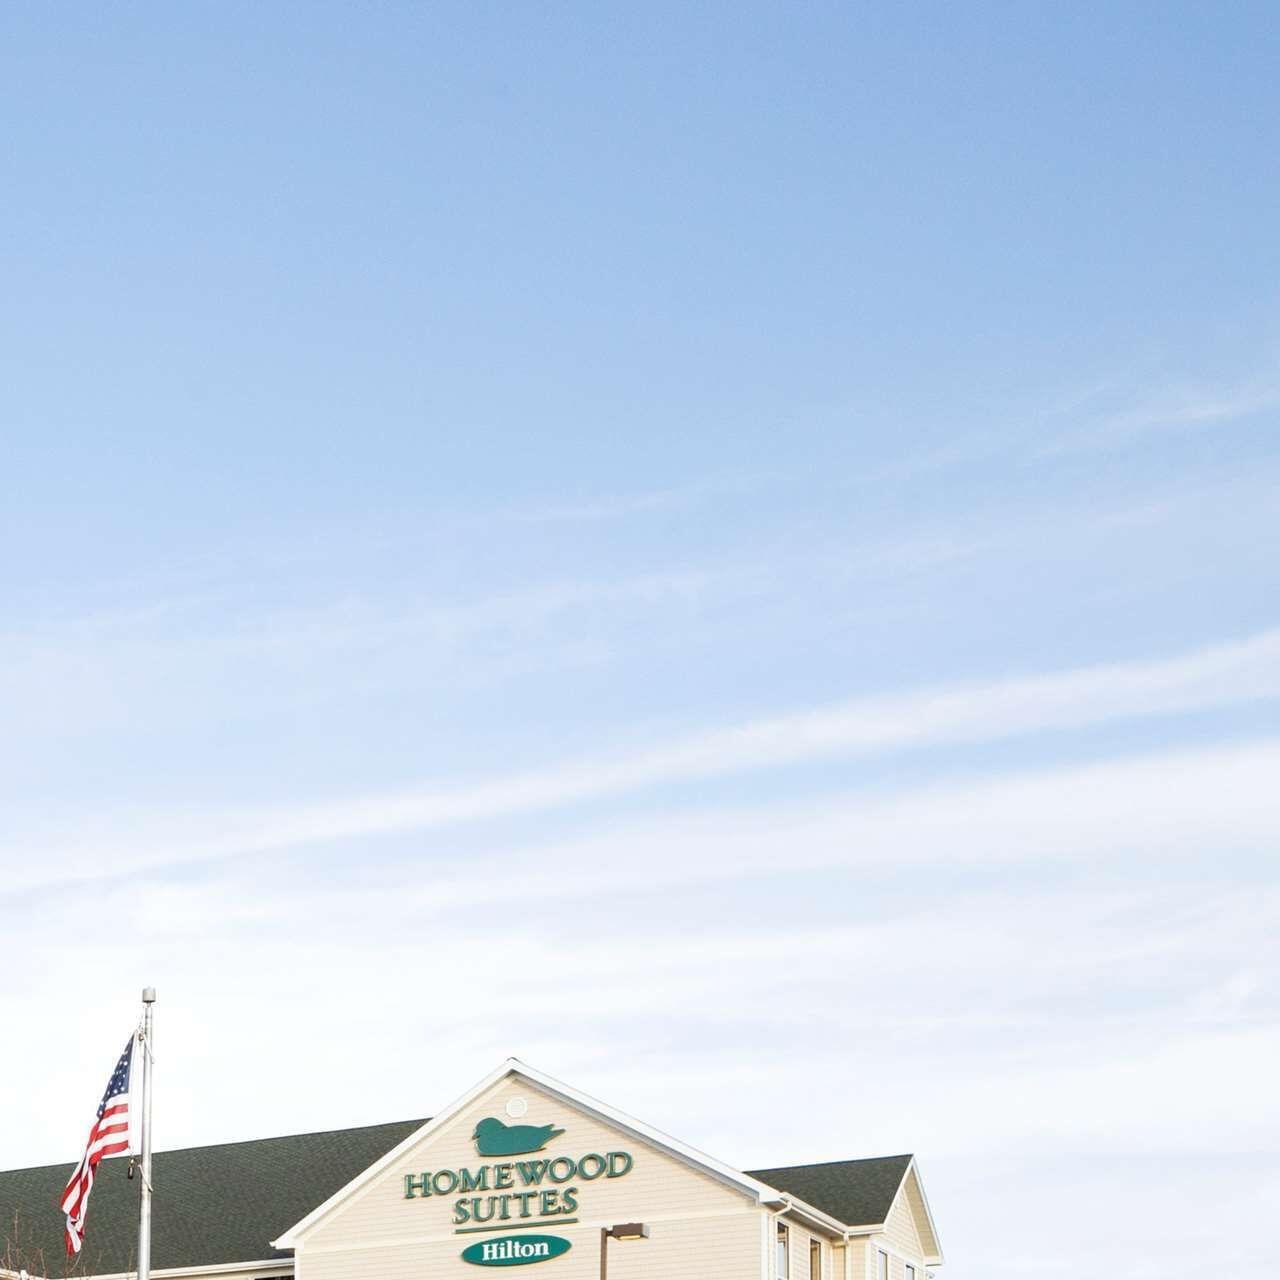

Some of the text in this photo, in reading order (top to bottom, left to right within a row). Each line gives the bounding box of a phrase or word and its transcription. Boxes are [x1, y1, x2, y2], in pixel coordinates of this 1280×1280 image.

[403, 1151, 634, 1200] HOMEWOOD
[452, 1186, 579, 1225] SUITES
[482, 1240, 549, 1262] Hilton
